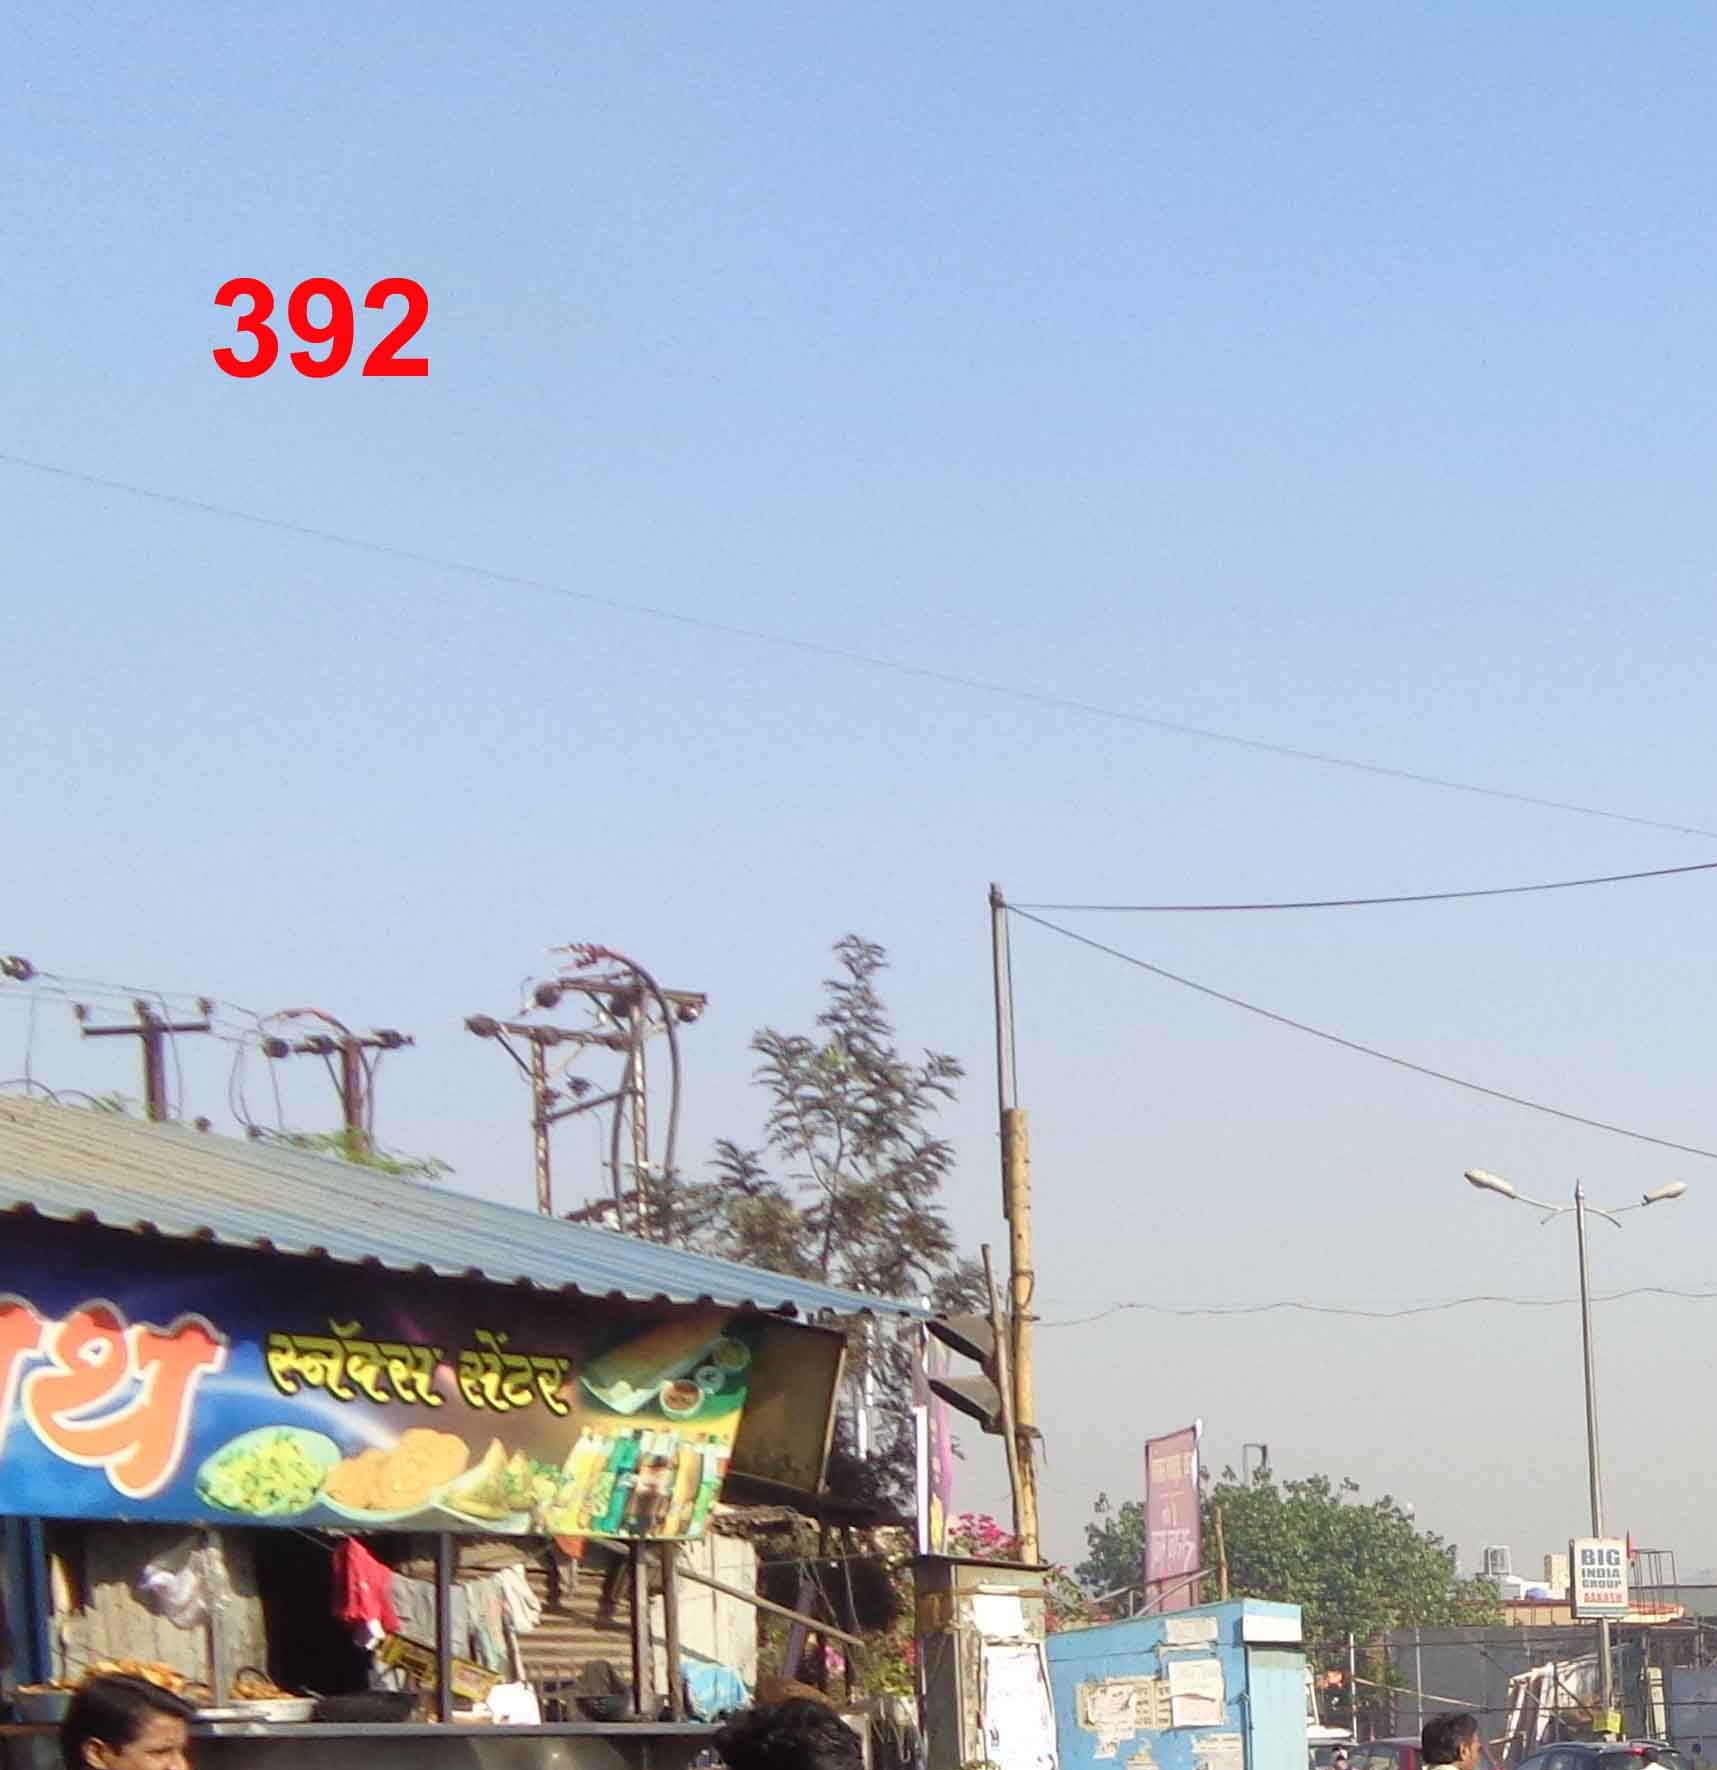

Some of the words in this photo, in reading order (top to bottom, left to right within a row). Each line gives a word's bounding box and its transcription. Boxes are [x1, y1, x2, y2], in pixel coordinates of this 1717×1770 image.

[455, 1328, 573, 1417] सेंटर
[1581, 1549, 1621, 1566] BIG
[1581, 1567, 1620, 1578] INDIA
[1582, 1579, 1621, 1588] GROUP
